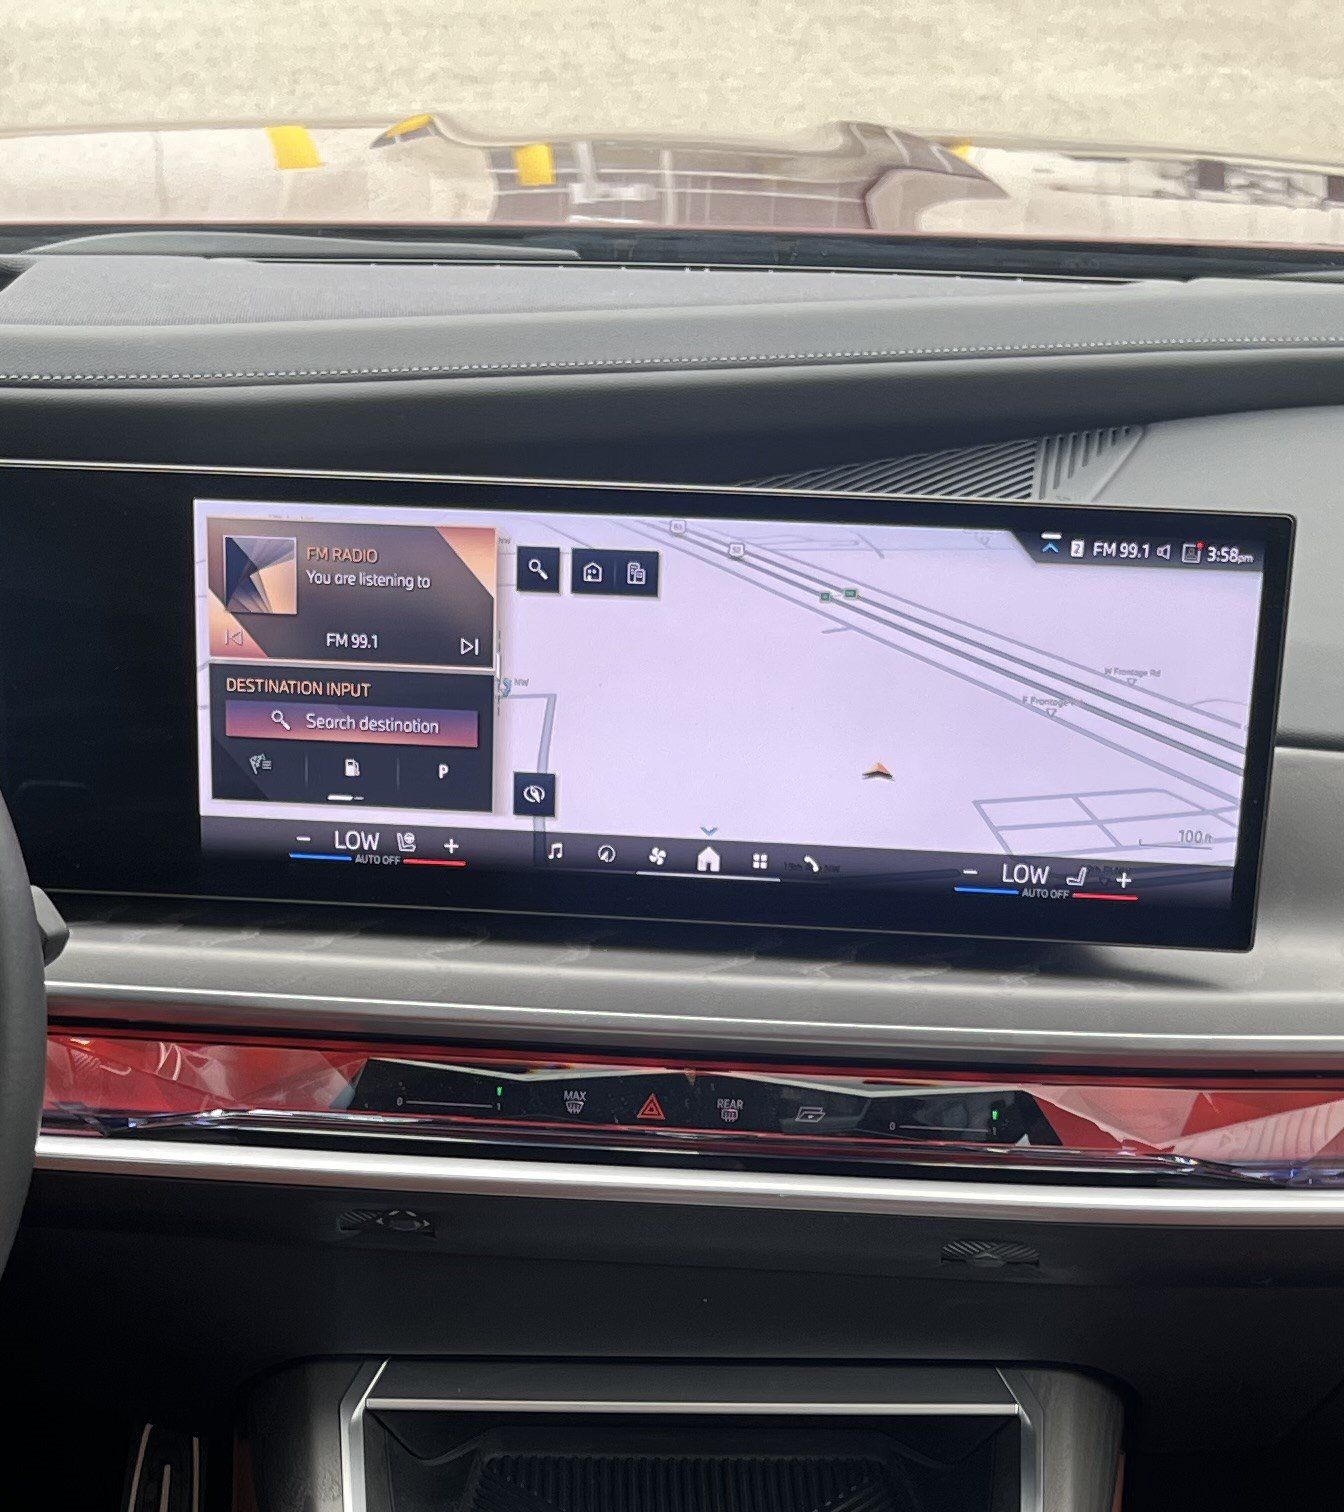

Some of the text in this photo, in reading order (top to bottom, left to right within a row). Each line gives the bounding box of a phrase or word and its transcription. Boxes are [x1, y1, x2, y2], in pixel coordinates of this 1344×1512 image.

[306, 547, 378, 564] FM RADIO
[1092, 543, 1117, 557] FM
[1119, 544, 1150, 558] 99.1
[306, 570, 431, 591] You are listening to
[326, 633, 378, 649] FM 99.1
[226, 677, 372, 698] DESTINATION INPUT
[306, 712, 440, 734] Search destination
[334, 830, 380, 851] LOW
[1178, 829, 1203, 844] 100
[355, 854, 401, 865] AUTO OFF
[1002, 863, 1049, 884] LOW
[1022, 887, 1070, 899] AUTO OFF
[563, 1090, 587, 1101] MAX
[716, 1098, 744, 1110] REAR
